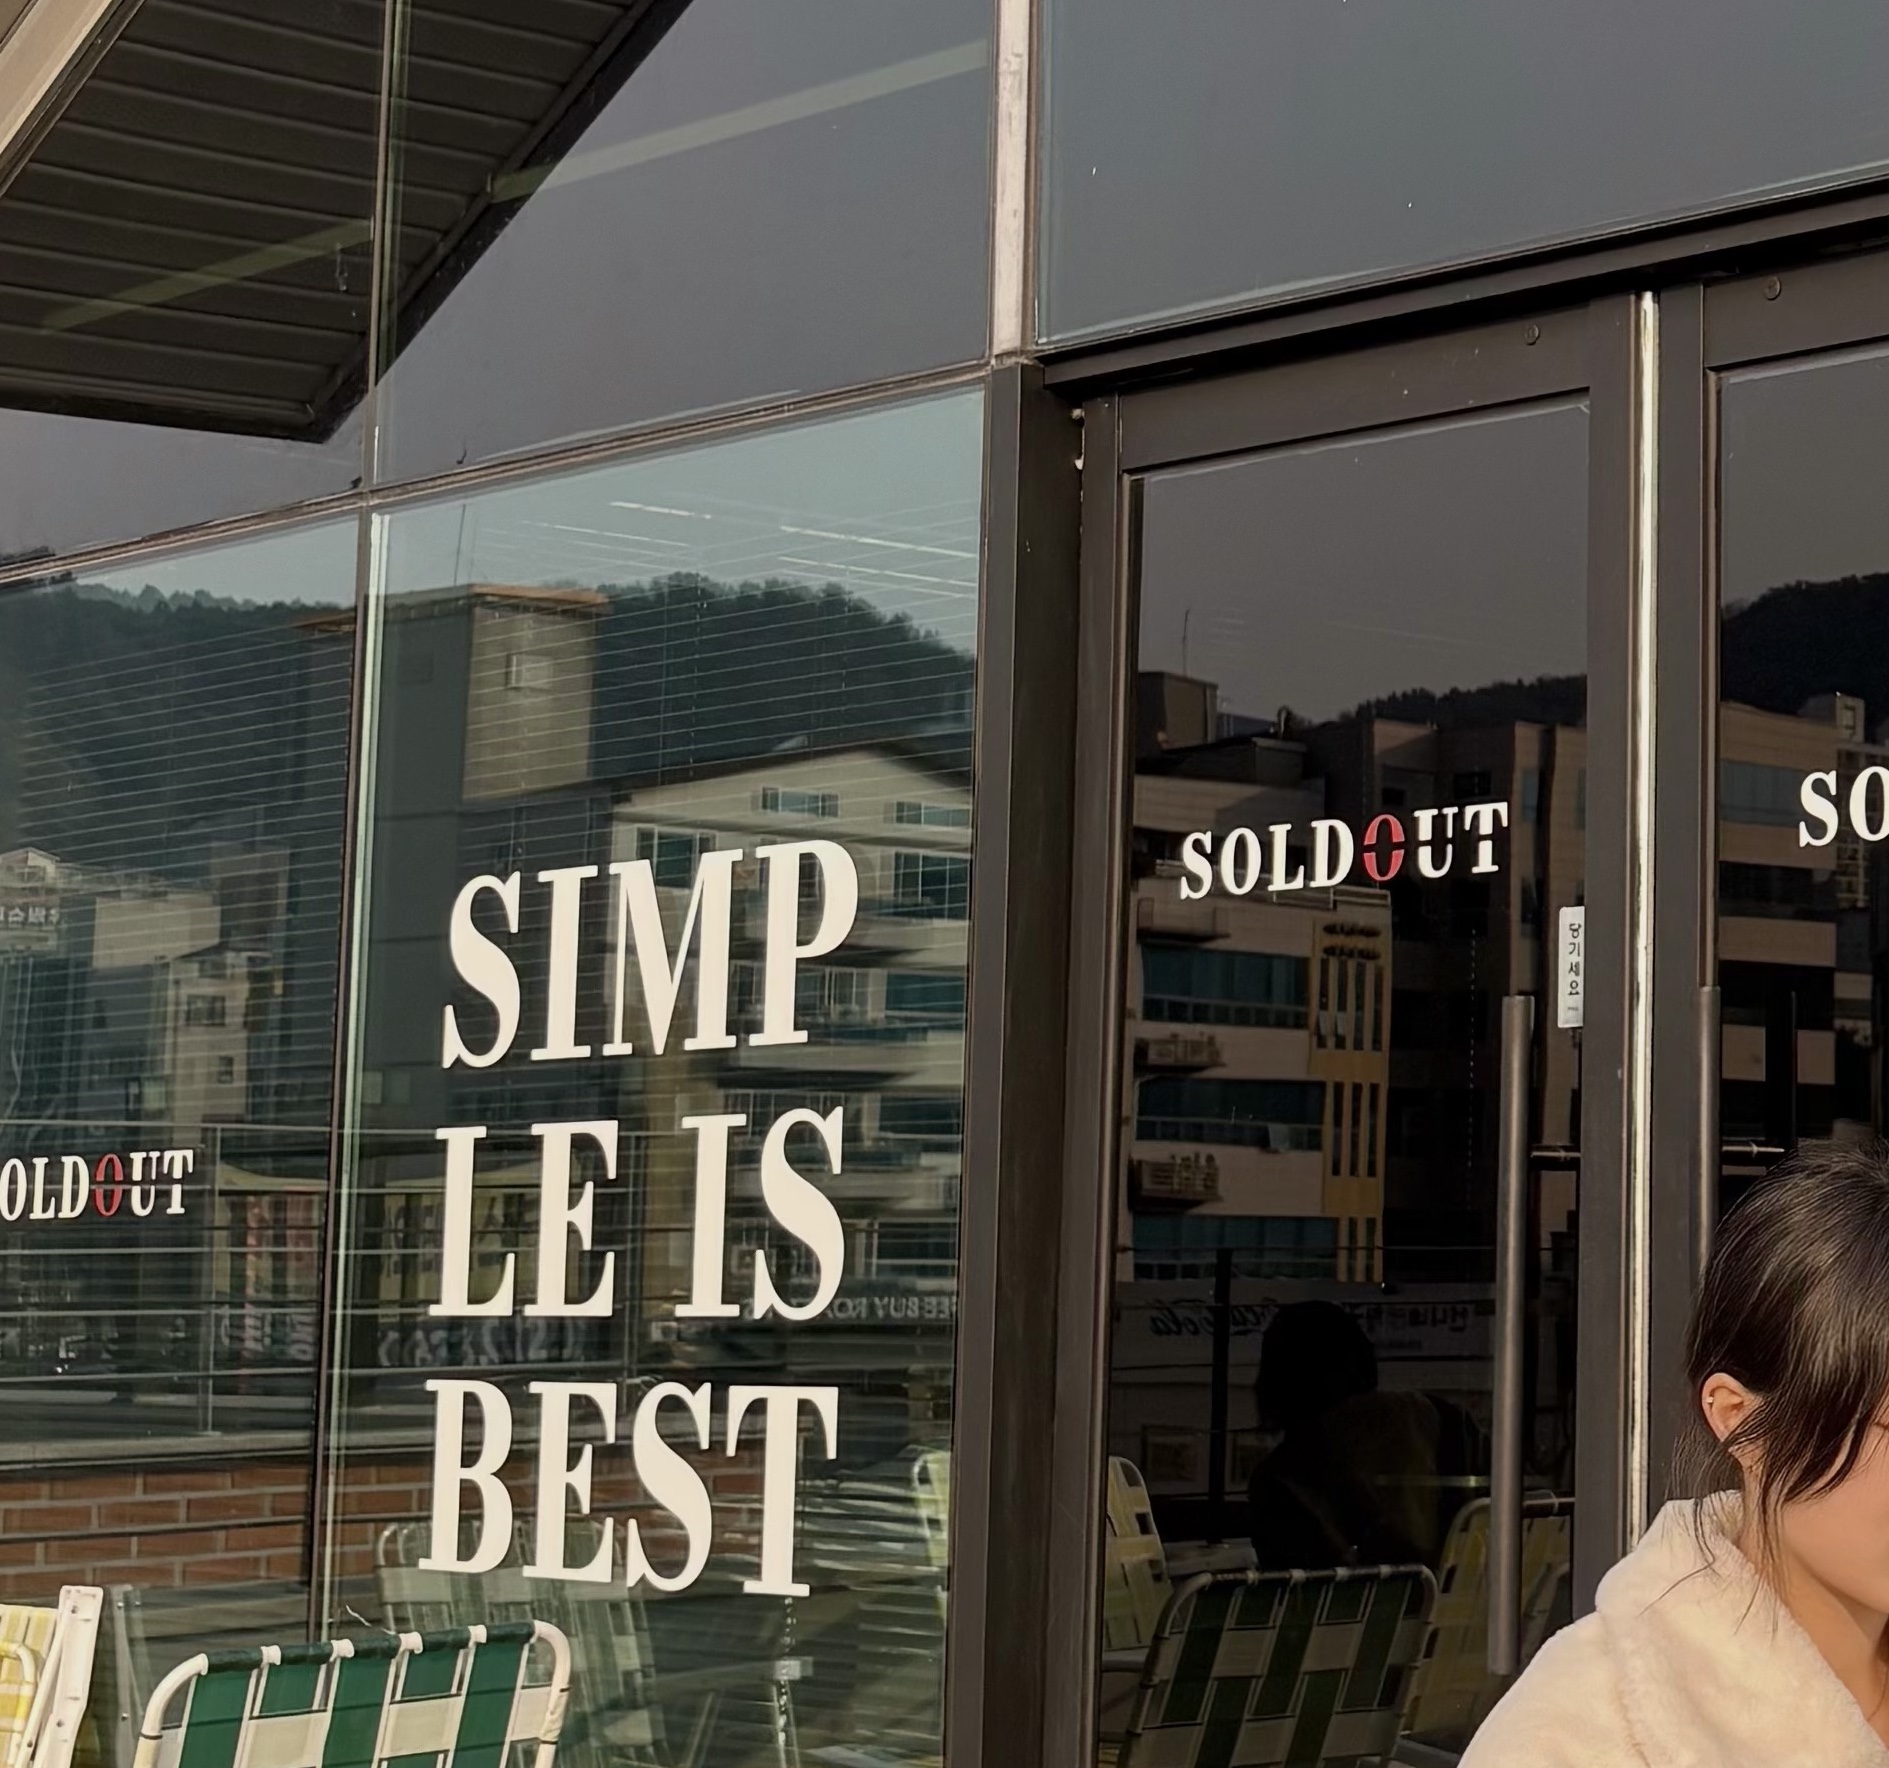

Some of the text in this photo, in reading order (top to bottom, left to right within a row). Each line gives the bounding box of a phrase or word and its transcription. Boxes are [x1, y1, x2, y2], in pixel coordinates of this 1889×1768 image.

[1181, 802, 1508, 900] SOLDOUT
[443, 839, 858, 1069] SIMP
[1568, 922, 1582, 996] 당기세요
[0, 1149, 194, 1221] OLDOUT
[428, 1120, 619, 1317] LE
[674, 1107, 845, 1321] IS
[418, 1379, 839, 1597] BEST
